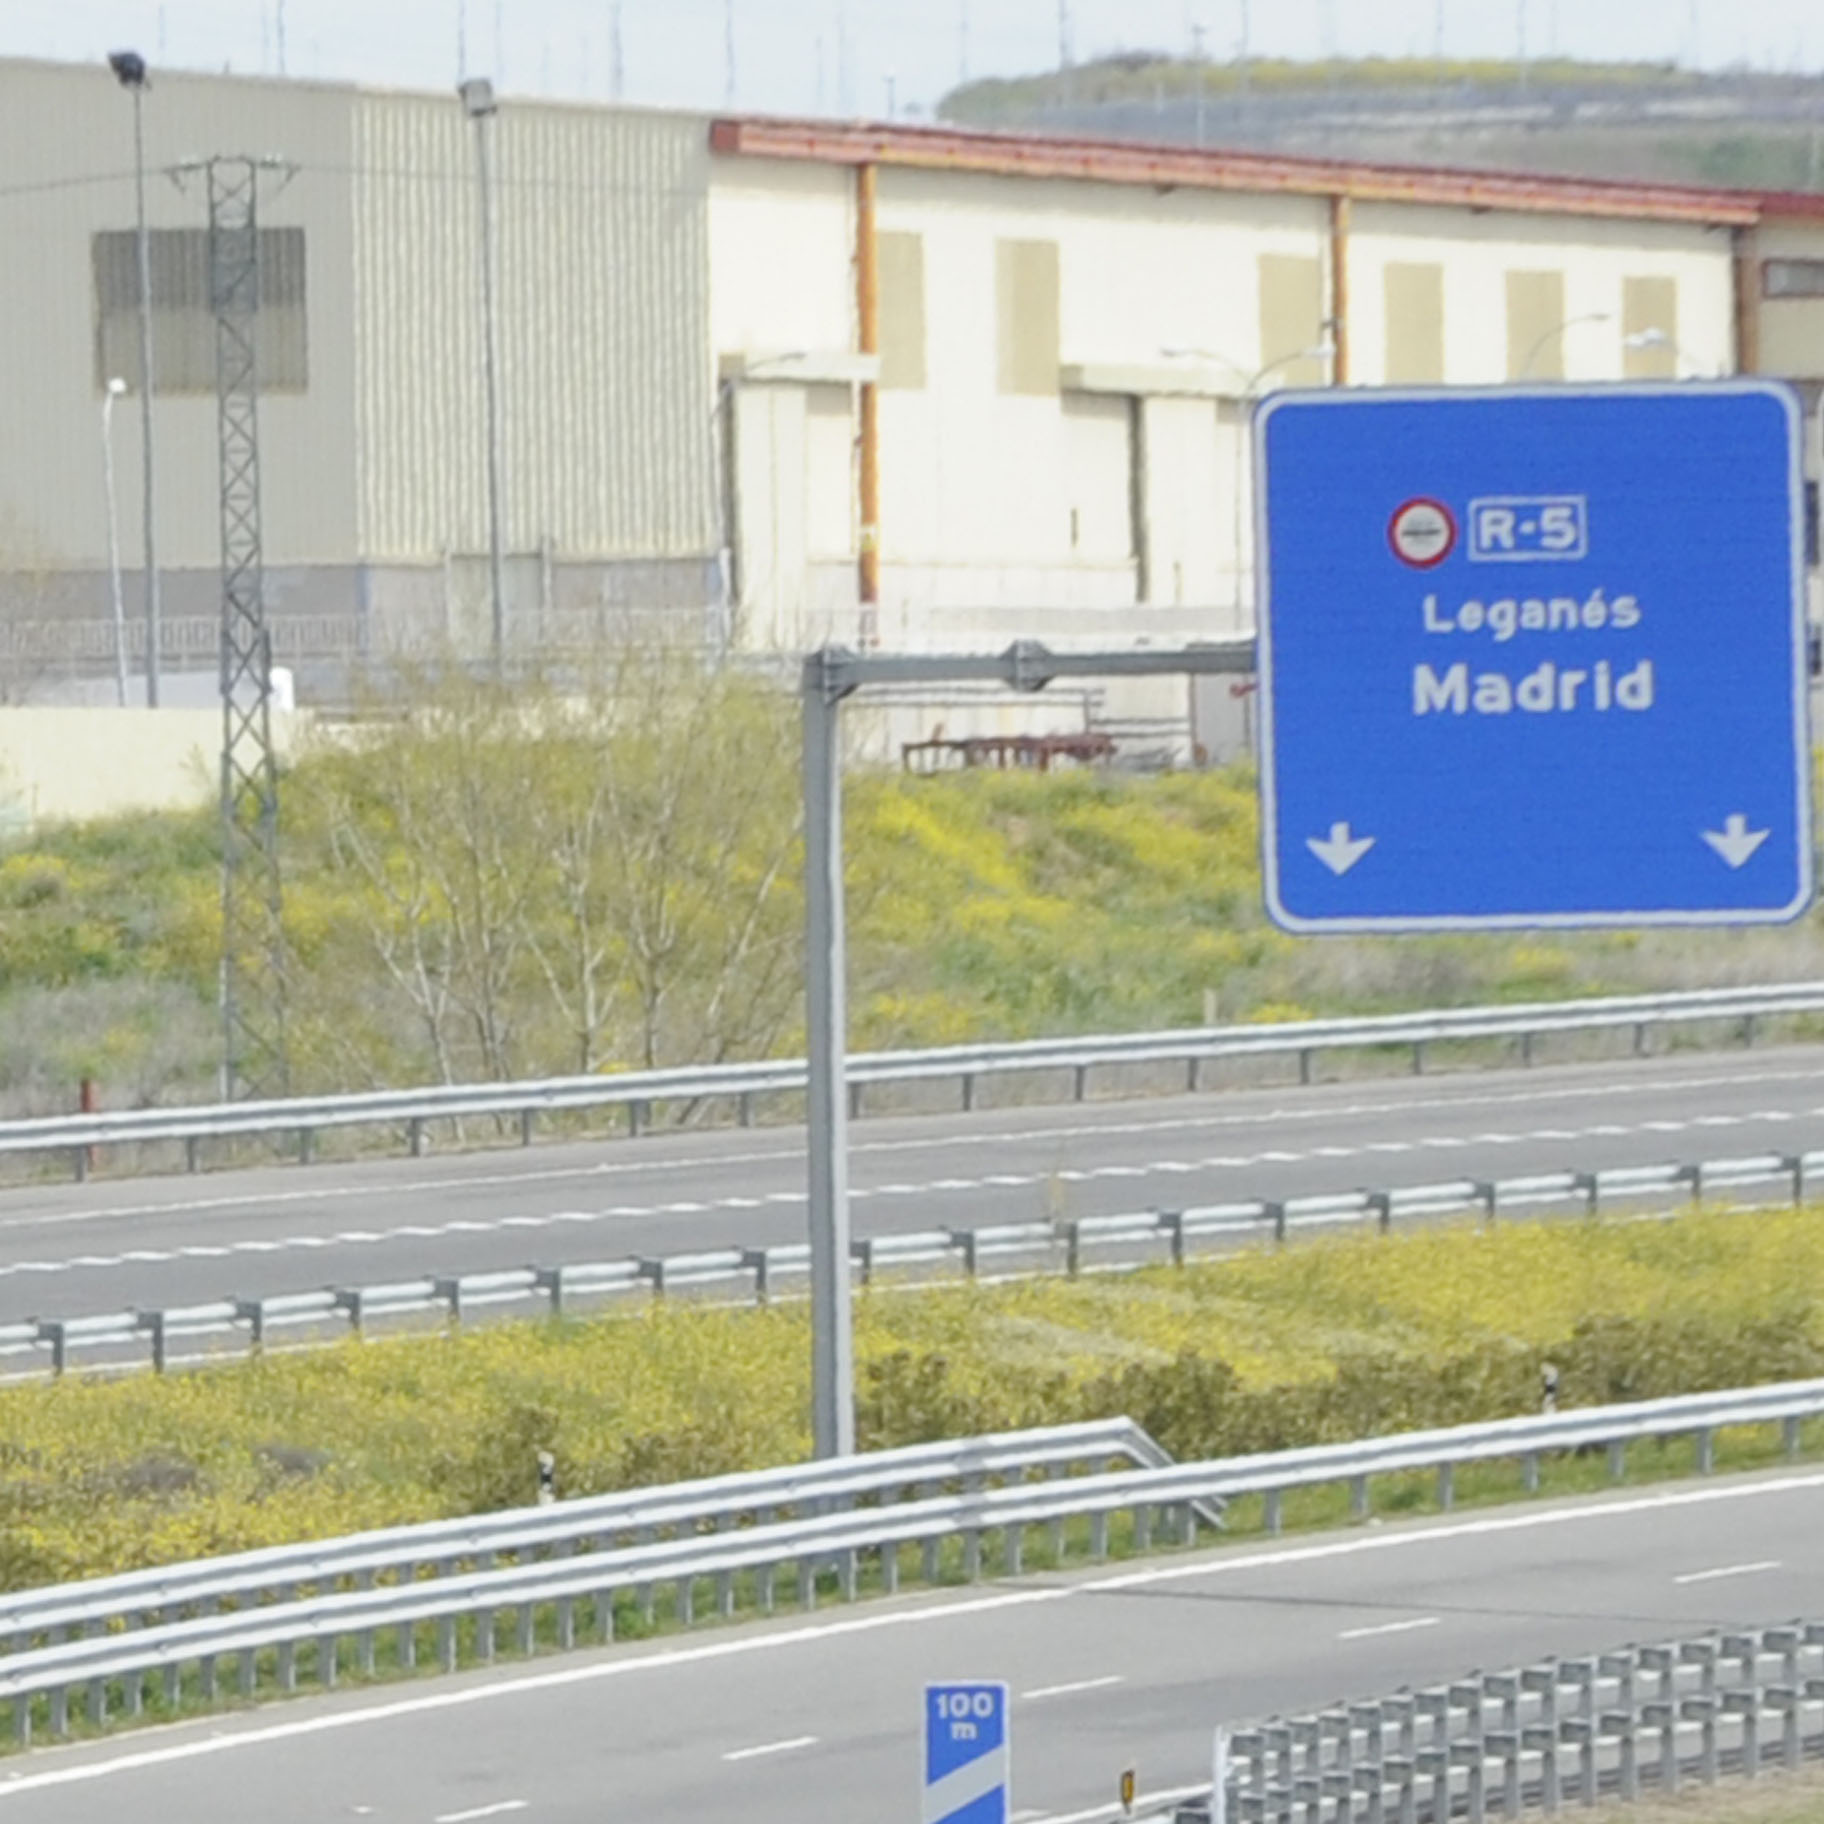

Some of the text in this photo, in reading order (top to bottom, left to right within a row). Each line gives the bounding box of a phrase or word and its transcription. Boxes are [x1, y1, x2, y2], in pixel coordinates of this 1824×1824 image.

[1479, 507, 1578, 550] R-5
[1423, 586, 1642, 642] Leganés
[1413, 659, 1654, 716] Madrid
[937, 1691, 995, 1720] 100
[949, 1721, 978, 1741] m
